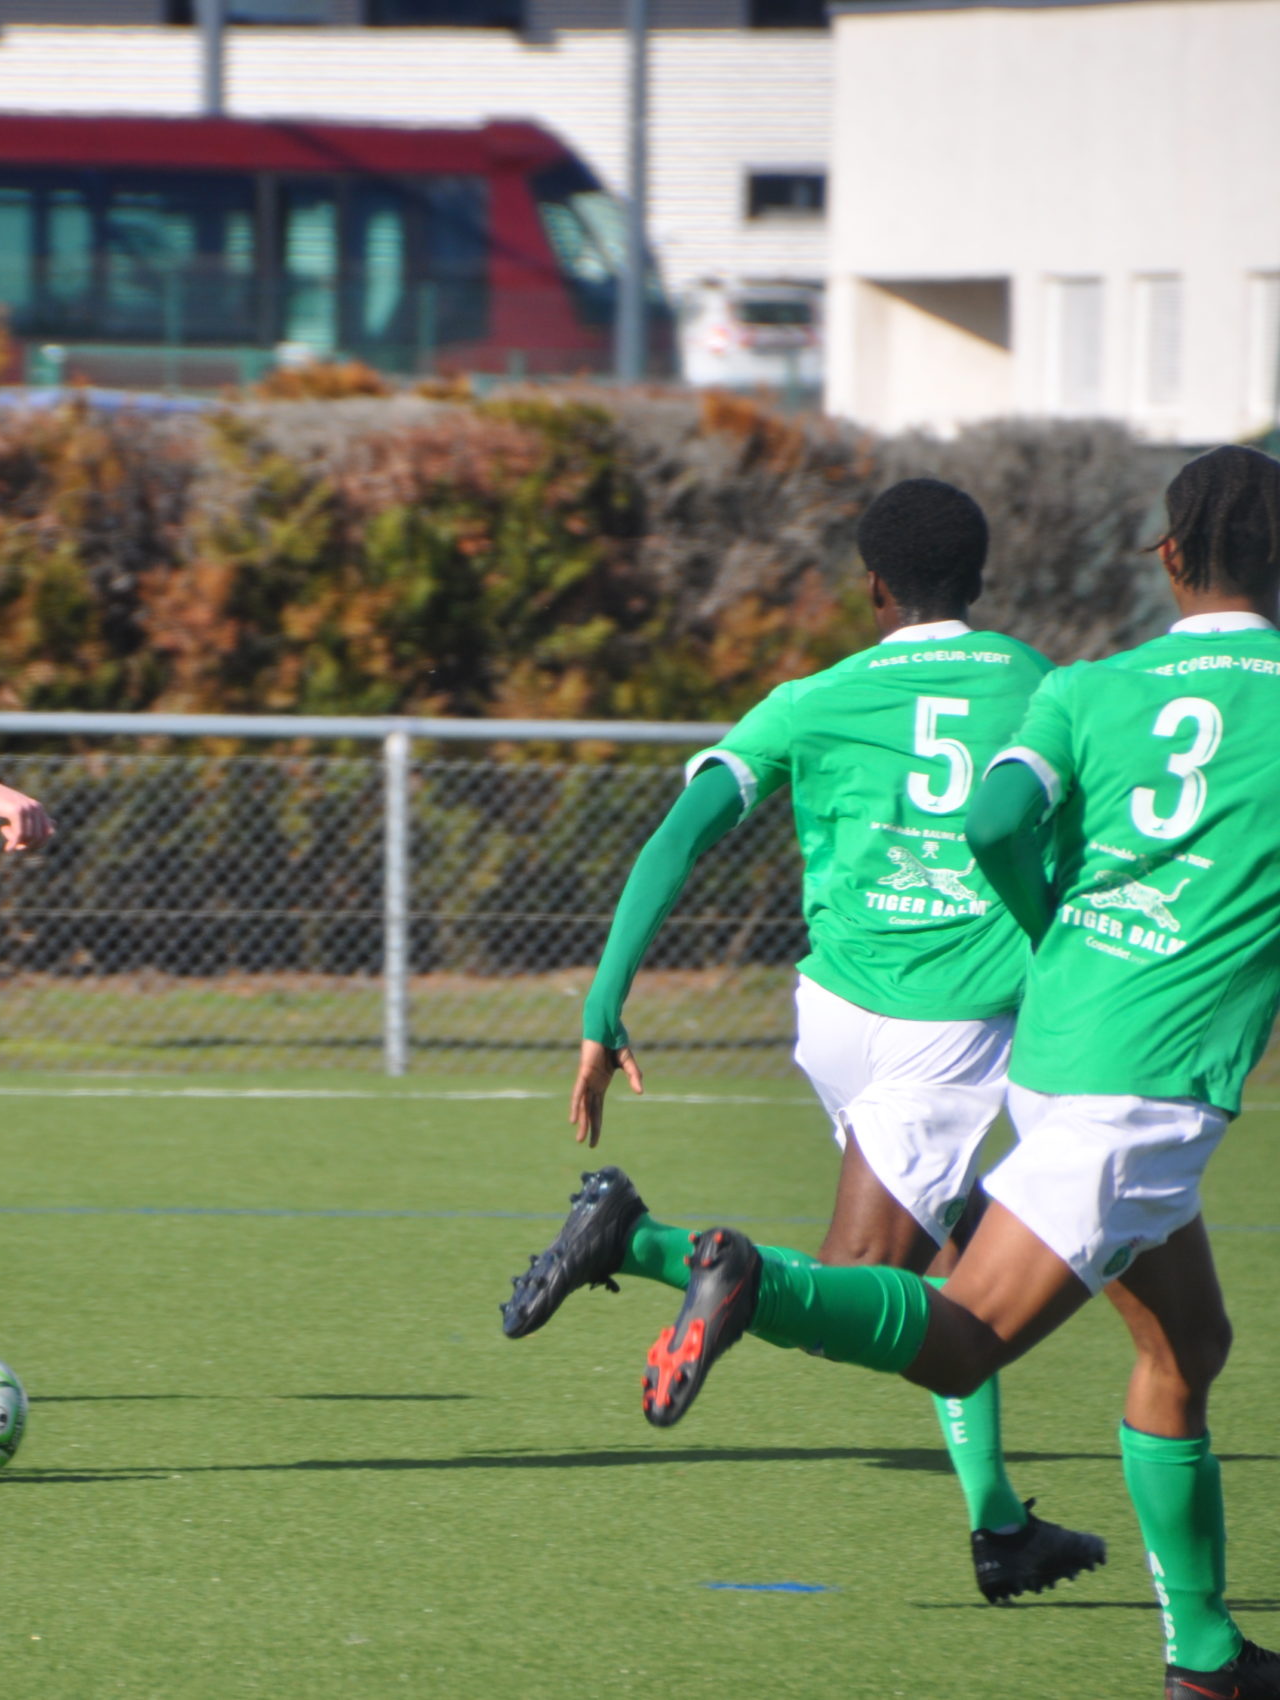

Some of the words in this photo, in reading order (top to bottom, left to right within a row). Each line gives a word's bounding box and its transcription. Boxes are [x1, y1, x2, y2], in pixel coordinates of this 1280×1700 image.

[868, 655, 909, 669] ASSE
[907, 695, 974, 814] 5
[1130, 696, 1223, 840] 3
[865, 891, 926, 914] TIGER
[931, 899, 987, 917] BALM
[1061, 903, 1123, 939] TIGER
